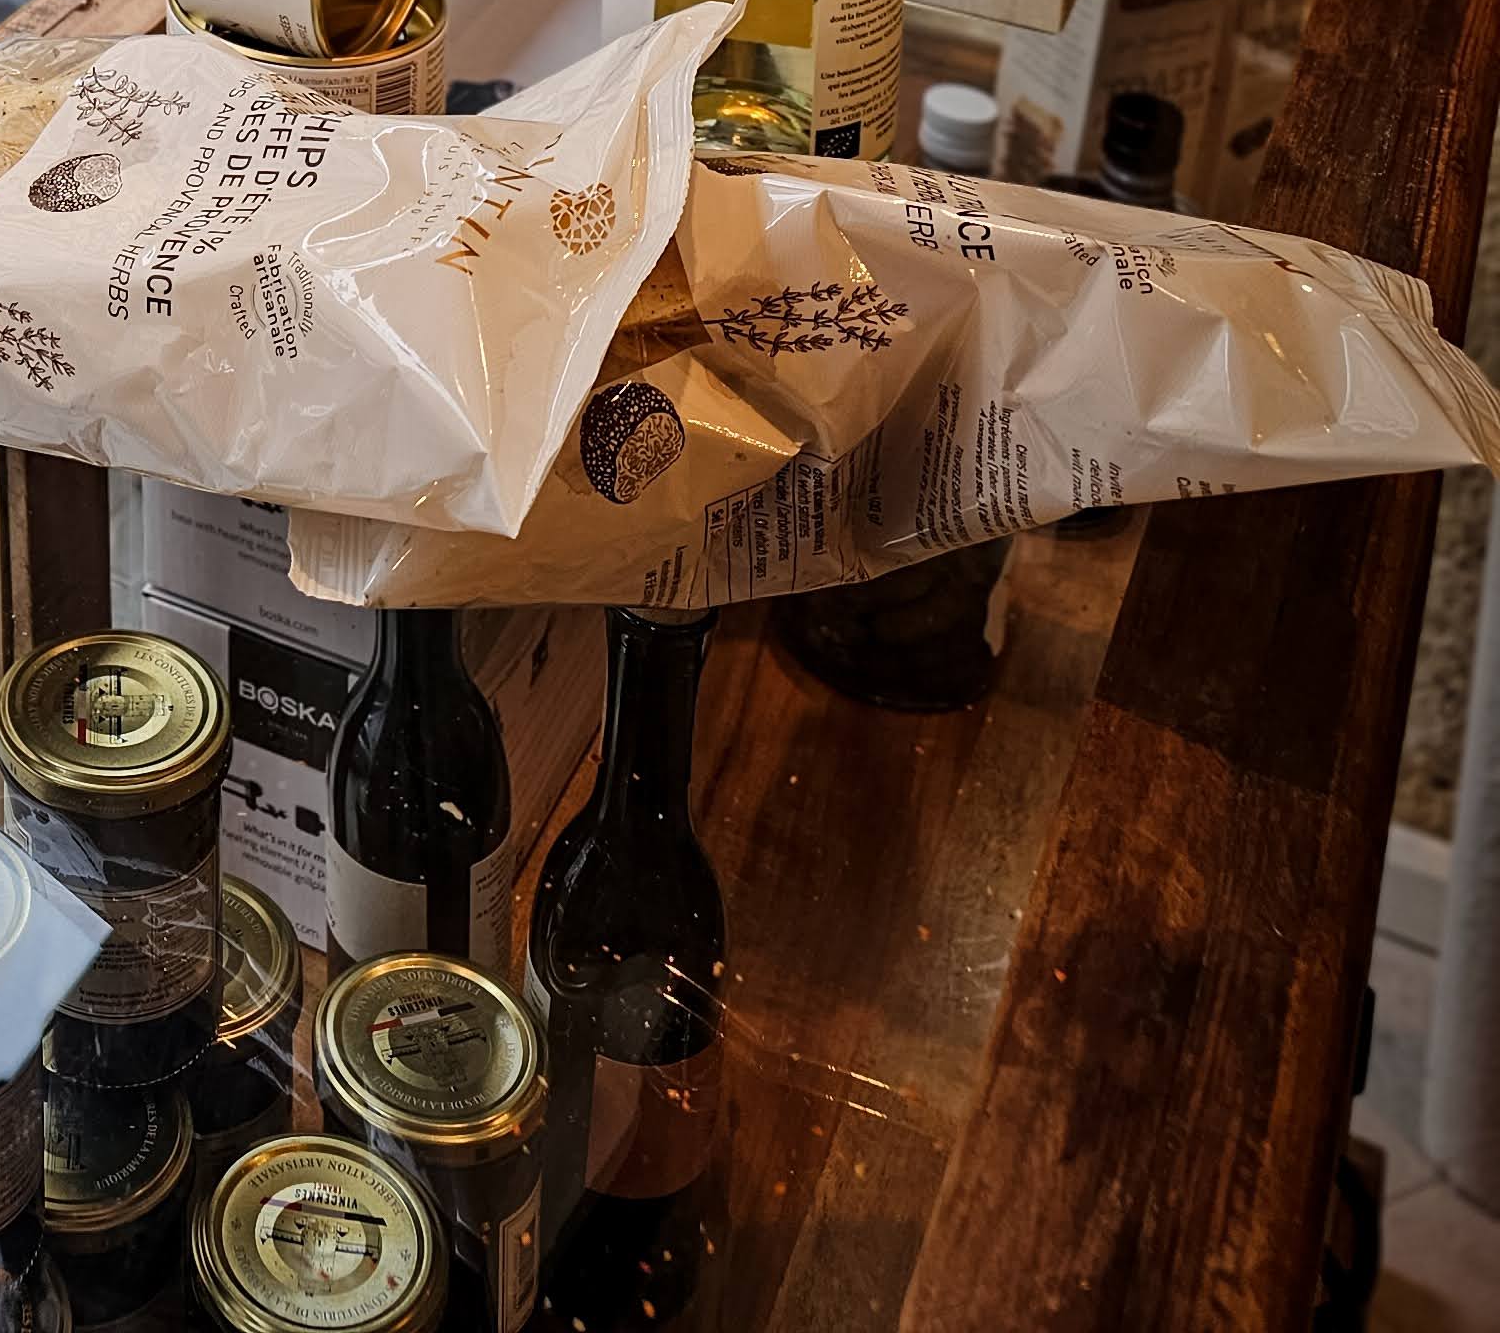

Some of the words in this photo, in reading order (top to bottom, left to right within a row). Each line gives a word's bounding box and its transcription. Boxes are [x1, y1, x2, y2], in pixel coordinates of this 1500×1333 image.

[205, 103, 234, 140] AND
[217, 153, 252, 185] DE
[285, 115, 342, 187] HIPS
[145, 195, 235, 316] PROVENCE
[191, 229, 232, 254] 1%
[1061, 232, 1100, 267] afted
[107, 245, 140, 320] HERBS
[267, 243, 298, 359] Fabrication
[287, 251, 314, 336] Traditionally
[229, 283, 256, 340] Crafted
[252, 253, 285, 357] artisanale
[1072, 475, 1082, 510] make
[1110, 462, 1122, 499] Invite
[257, 604, 320, 637] boska.com
[133, 650, 153, 662] LES
[234, 677, 339, 732] BOSKA
[387, 995, 443, 1016] VINCENNES
[246, 1157, 323, 1188] ARTISANALE
[326, 1158, 403, 1215] FABRICATION
[293, 1187, 357, 1209] VINCENNES
